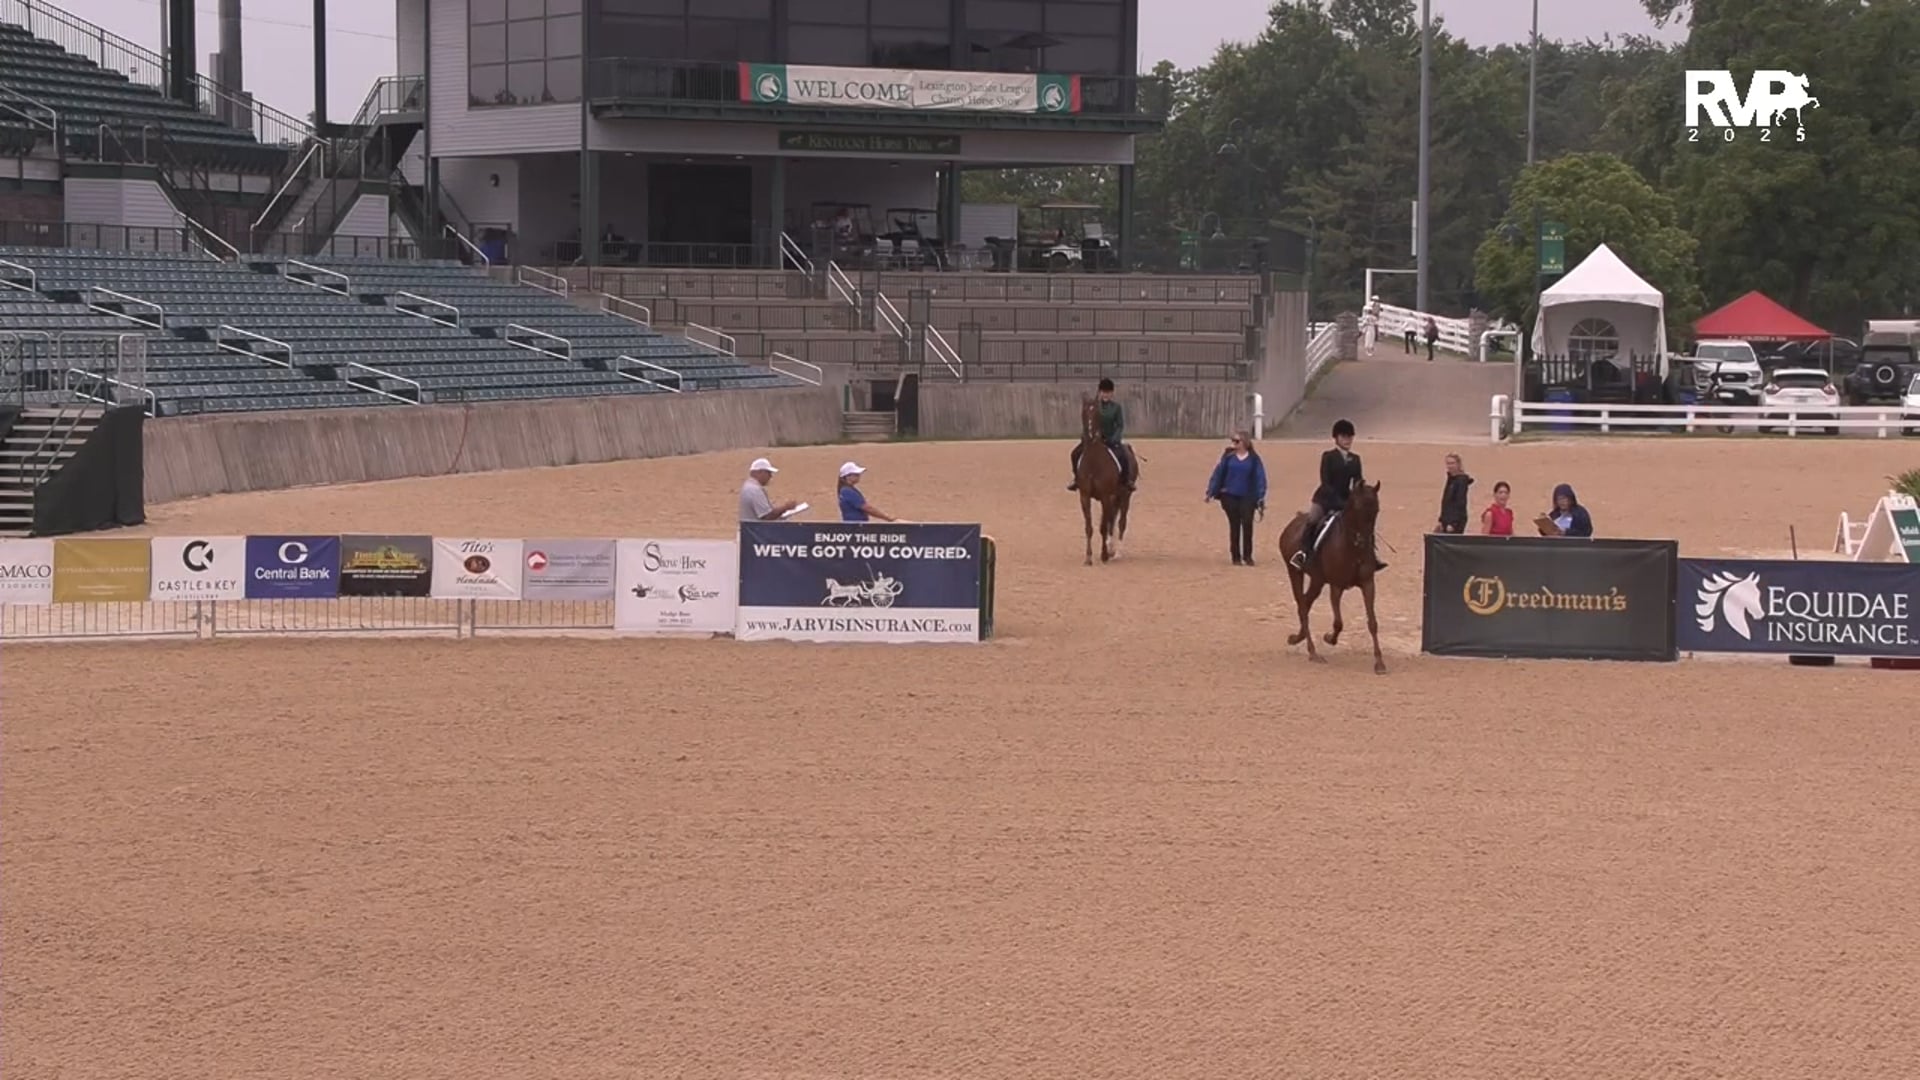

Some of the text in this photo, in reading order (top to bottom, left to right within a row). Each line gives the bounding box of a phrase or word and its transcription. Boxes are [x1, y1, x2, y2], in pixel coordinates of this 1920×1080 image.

[793, 79, 911, 101] WELCOME
[919, 80, 967, 94] Lexington
[968, 95, 995, 105] Horse
[814, 533, 906, 544] ENJOY THE RIDE
[461, 541, 495, 553] Tito's
[753, 544, 972, 560] WE'VE GOT YOU COVERED.
[255, 566, 330, 580] Central Bank
[158, 580, 201, 592] CASTLE
[215, 580, 236, 591] KEY
[456, 576, 498, 585] Handmade
[1463, 575, 1627, 616] Freedman's
[1767, 586, 1909, 622] EQUIDAE
[1767, 621, 1908, 645] INSURANCE
